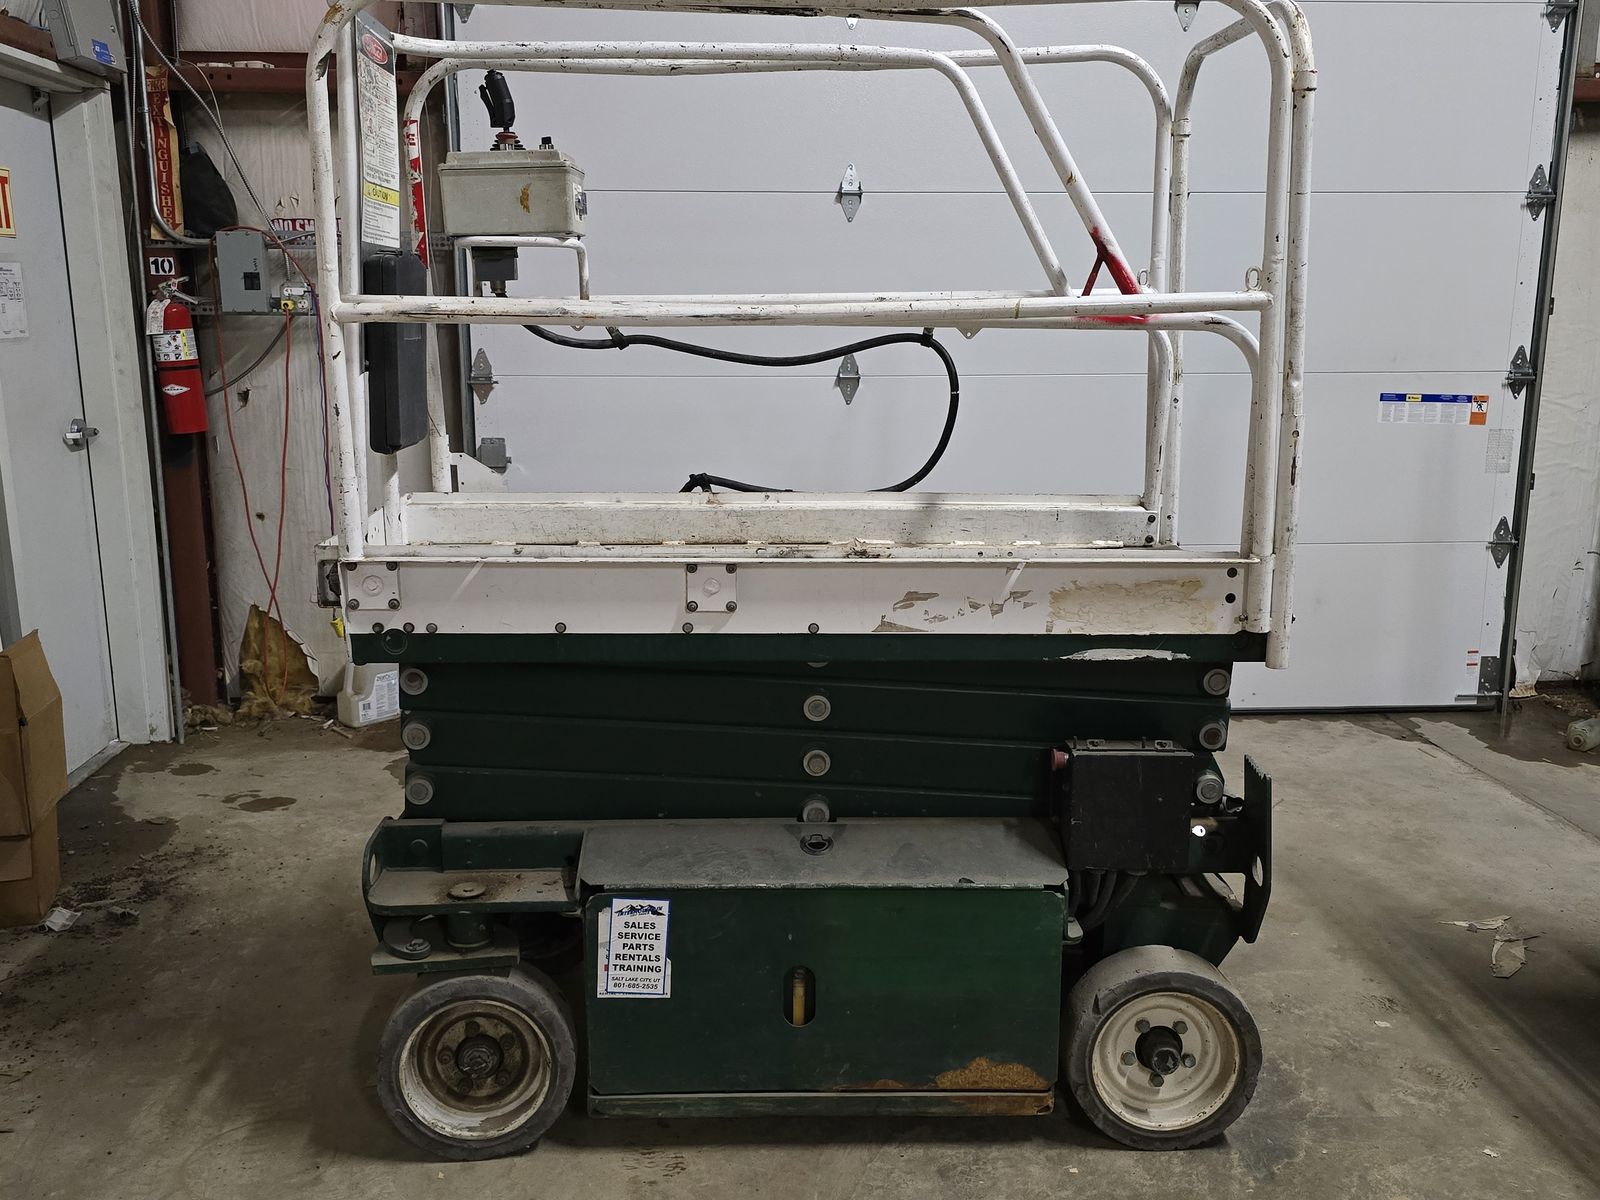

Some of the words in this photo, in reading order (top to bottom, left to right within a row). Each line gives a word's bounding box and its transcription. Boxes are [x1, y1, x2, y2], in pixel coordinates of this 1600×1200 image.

[147, 79, 167, 92] FIRE
[150, 258, 173, 274] 10
[624, 921, 656, 930] SALES
[617, 932, 661, 941] SERVICE
[622, 943, 655, 951] PARTS
[615, 953, 661, 962] RENTALS
[612, 964, 662, 973] TRAINING
[613, 982, 659, 990] 801-685-2535
